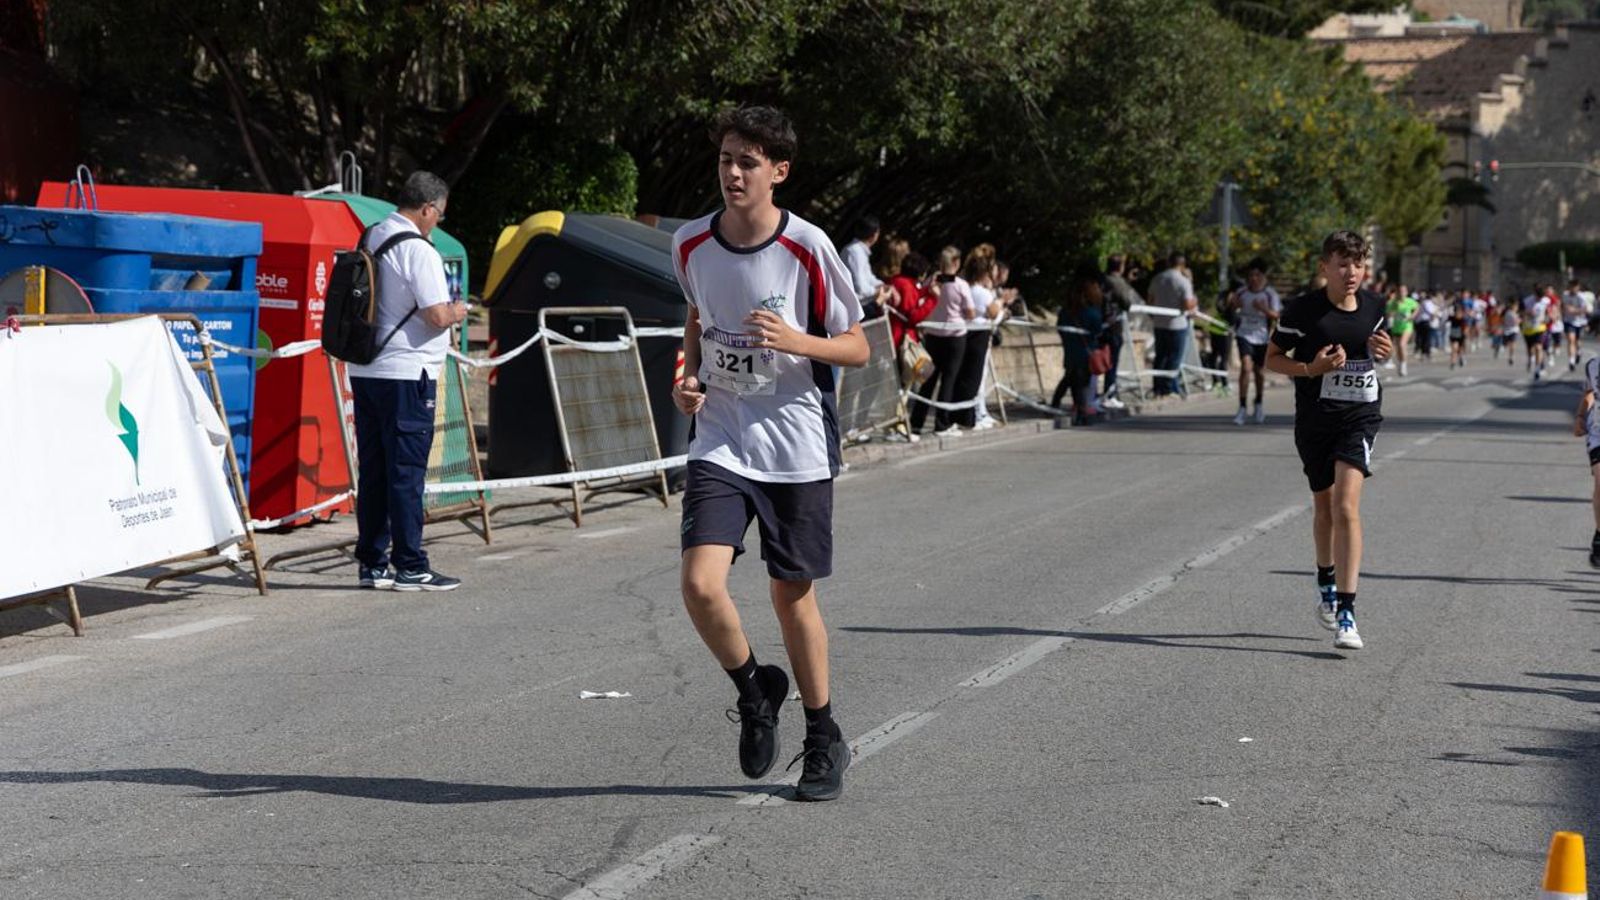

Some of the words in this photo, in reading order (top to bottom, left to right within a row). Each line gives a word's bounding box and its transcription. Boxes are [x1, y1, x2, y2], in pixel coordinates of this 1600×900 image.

[255, 273, 288, 287] oble
[173, 320, 196, 330] PAPE
[203, 320, 233, 330] CARTON
[715, 349, 754, 374] 321
[1331, 375, 1375, 388] 1552
[138, 487, 168, 505] Municipal
[168, 488, 177, 499] de
[121, 511, 149, 528] Deportes
[149, 510, 159, 521] de
